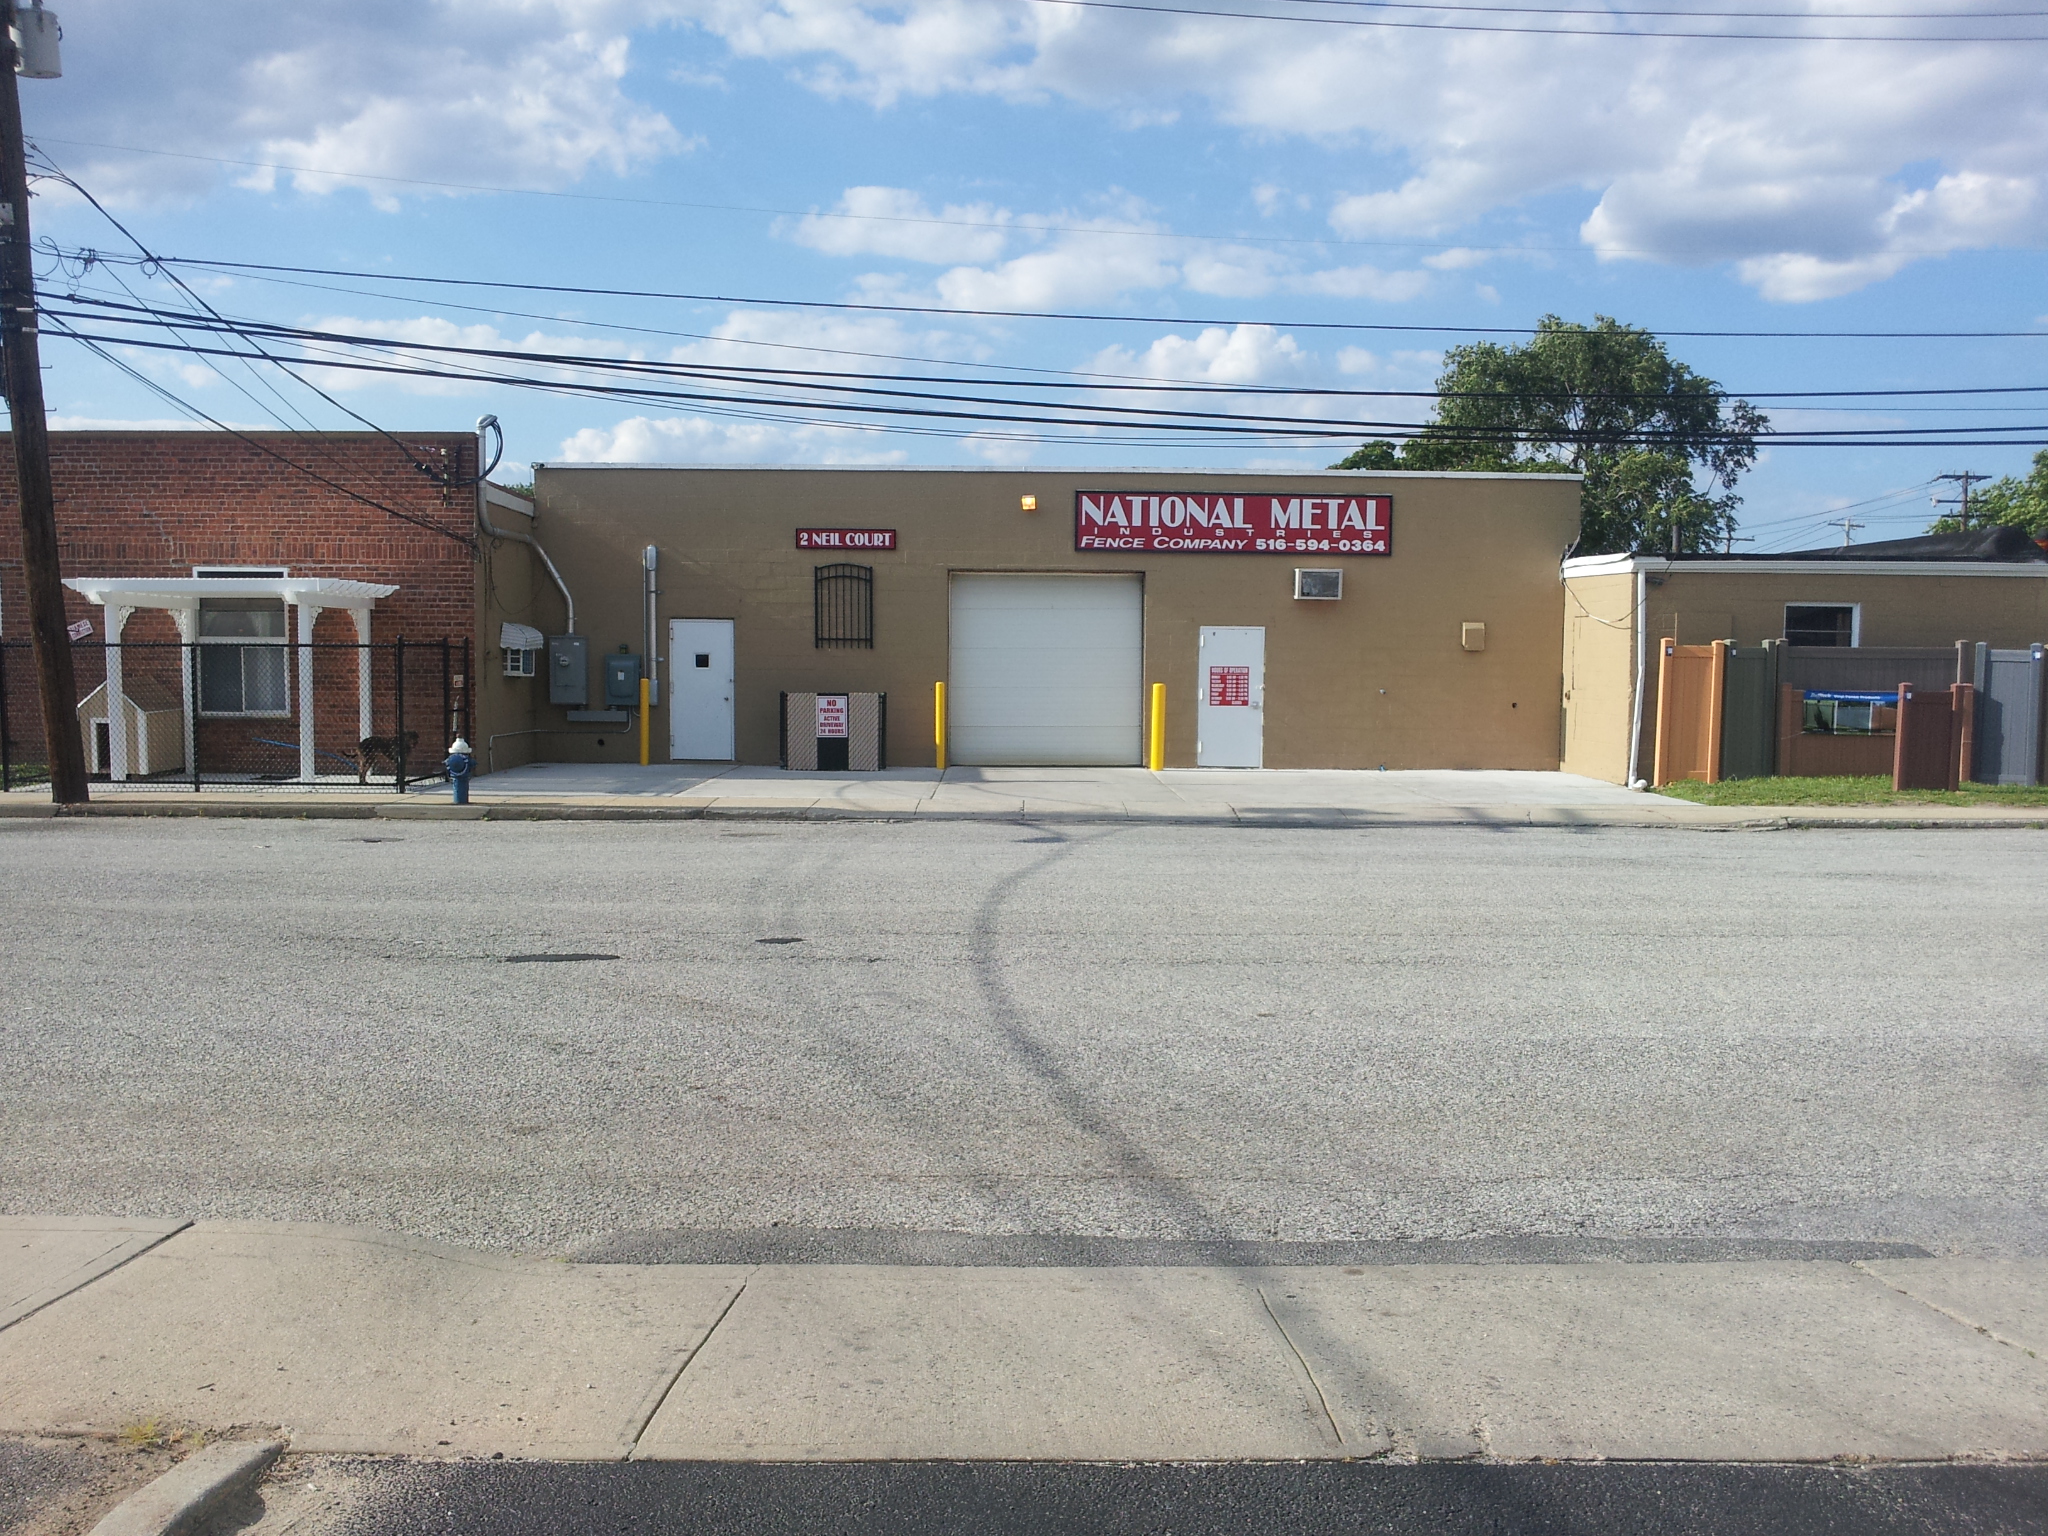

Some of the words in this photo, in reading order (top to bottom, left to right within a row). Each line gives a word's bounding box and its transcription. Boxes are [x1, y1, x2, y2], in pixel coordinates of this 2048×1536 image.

[1081, 496, 1252, 528] NATIONAL
[1270, 498, 1385, 530] METAL
[800, 532, 808, 546] 2
[812, 532, 843, 546] NEIL
[845, 533, 892, 546] COURT
[1080, 535, 1145, 548] FENCE
[1153, 536, 1248, 550] COMPANY
[1255, 538, 1385, 552] 516-594-0364
